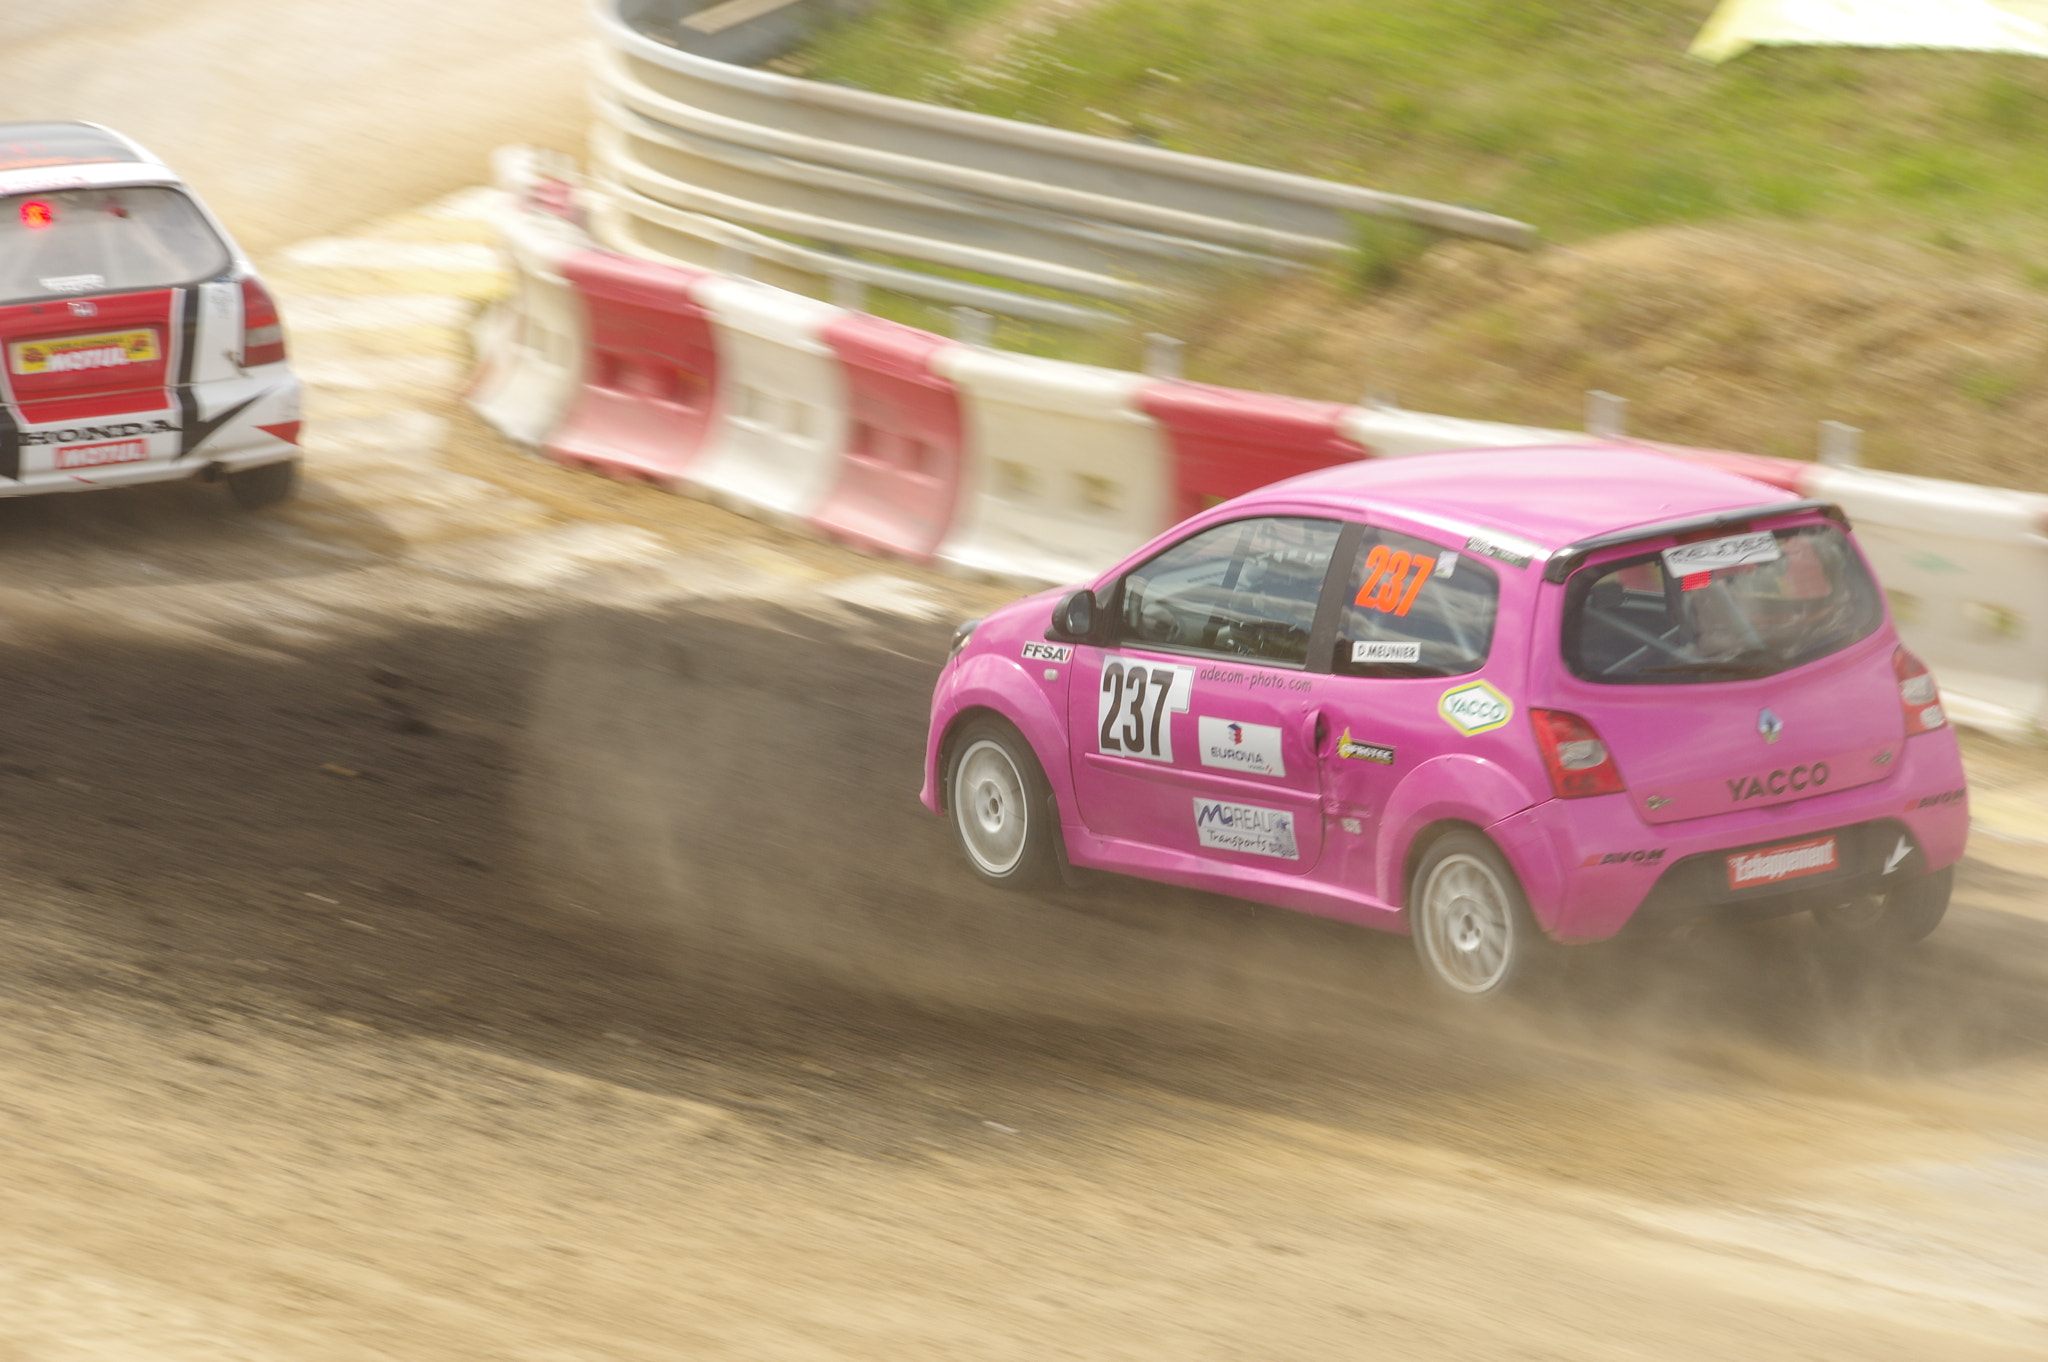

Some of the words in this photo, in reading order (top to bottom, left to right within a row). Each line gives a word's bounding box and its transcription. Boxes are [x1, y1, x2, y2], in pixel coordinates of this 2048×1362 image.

[18, 419, 184, 446] HONDA
[1354, 545, 1436, 617] 237
[1022, 643, 1064, 661] FFSA
[1101, 662, 1174, 756] 237
[1451, 699, 1503, 720] YACCO
[1211, 746, 1264, 764] EUROVIA
[1726, 761, 1829, 802] YACCO
[1198, 804, 1273, 833] MOREAU
[1207, 829, 1268, 852] Transports
